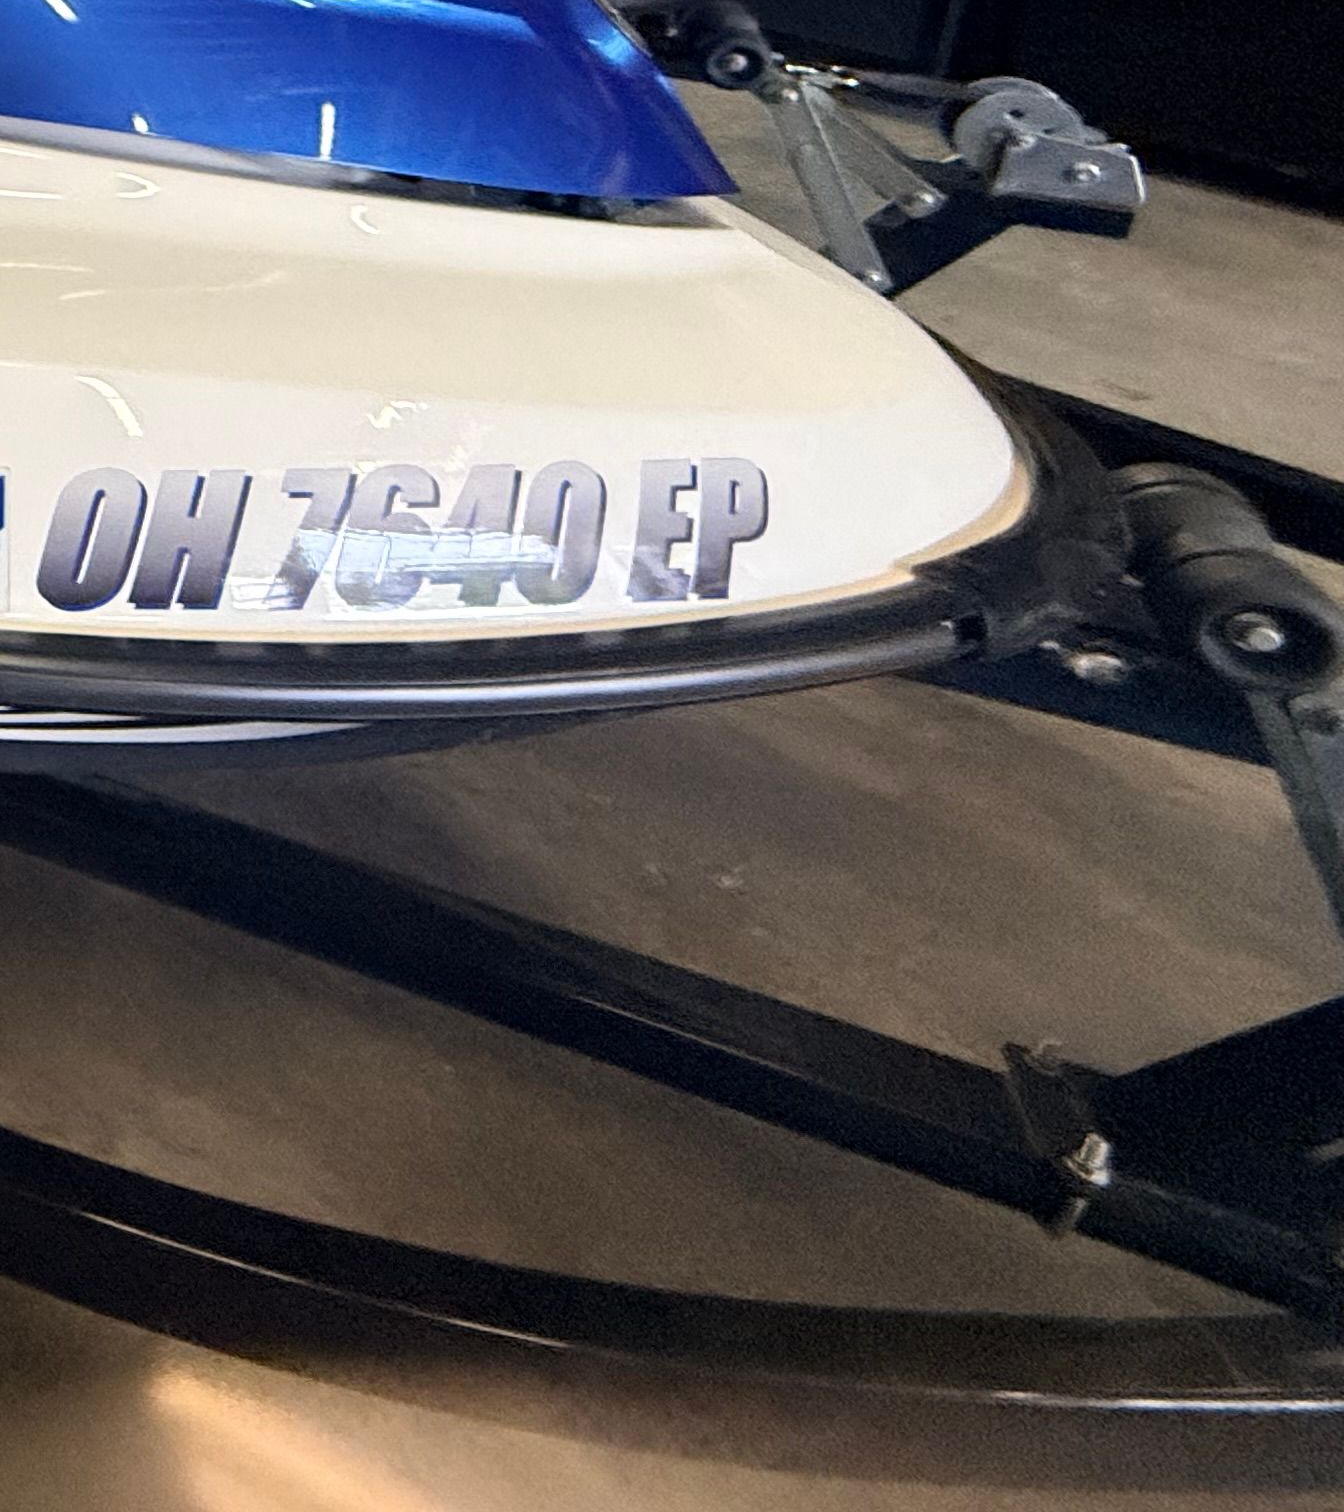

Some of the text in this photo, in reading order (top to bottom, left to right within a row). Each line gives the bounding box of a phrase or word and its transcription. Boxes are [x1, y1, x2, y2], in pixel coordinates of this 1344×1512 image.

[36, 457, 768, 611] OH 7640 EP
